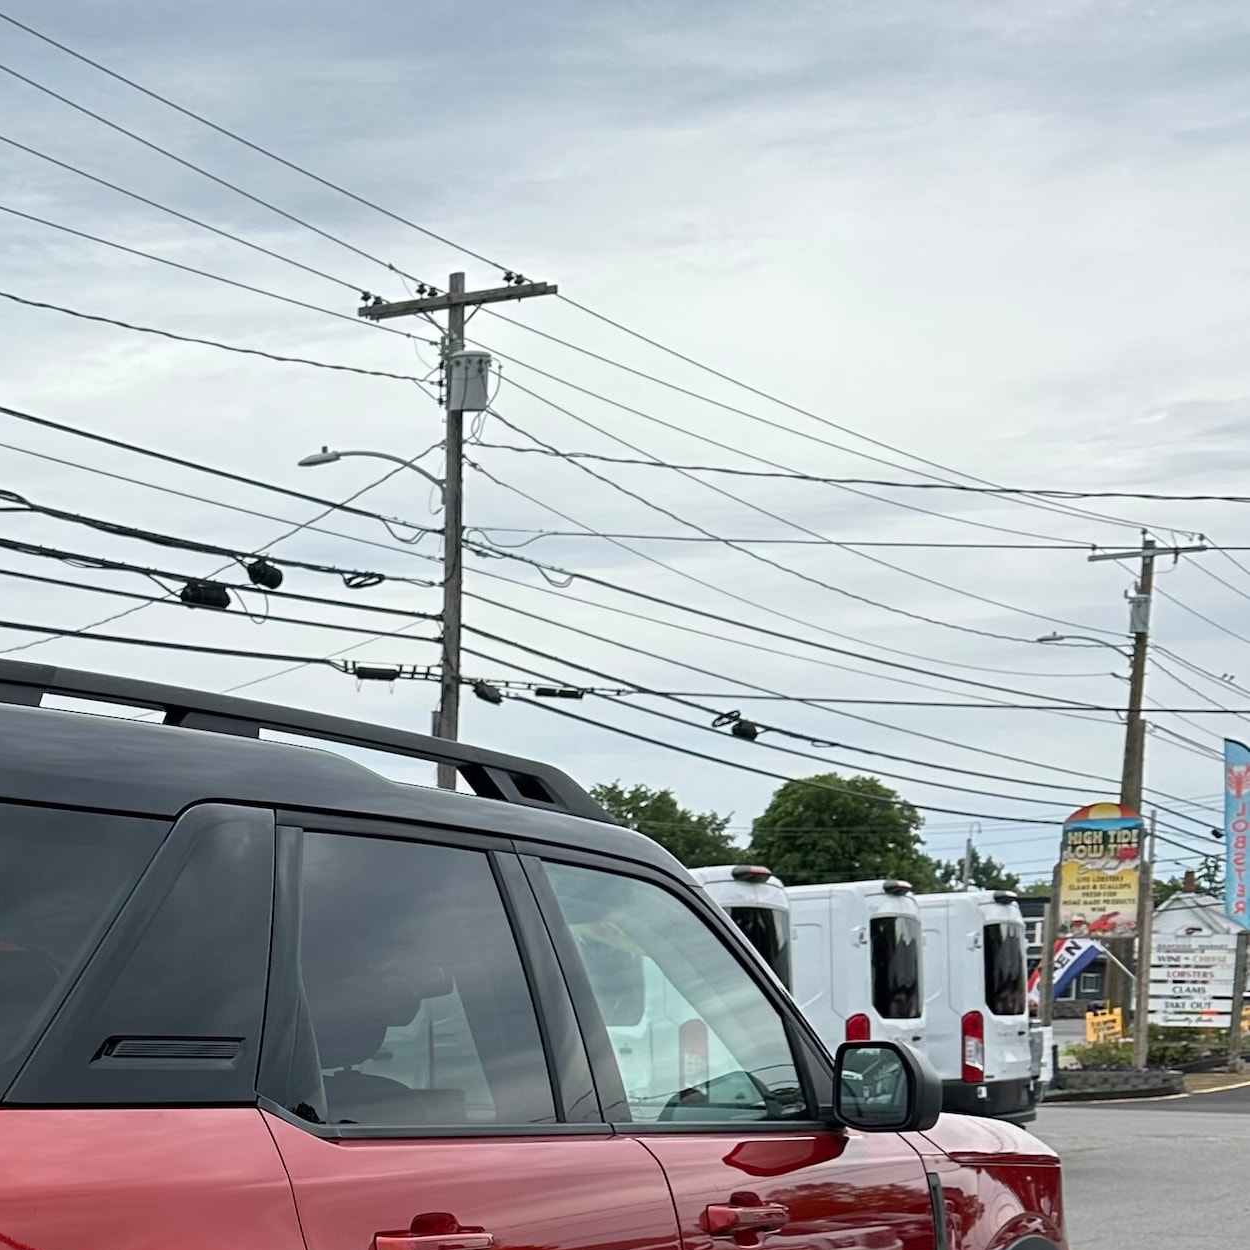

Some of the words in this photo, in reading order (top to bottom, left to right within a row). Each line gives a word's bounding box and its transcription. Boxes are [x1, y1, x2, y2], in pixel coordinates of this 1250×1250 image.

[1067, 831, 1103, 845] HIGH
[1108, 829, 1140, 844] TIDE
[1067, 845, 1104, 858] LOW
[1157, 955, 1181, 963] WINE
[1166, 970, 1215, 979] LOBSTERS
[1171, 986, 1207, 995] CLAMS
[1164, 1001, 1186, 1009] TAKE
[1190, 1001, 1213, 1009] OUT
